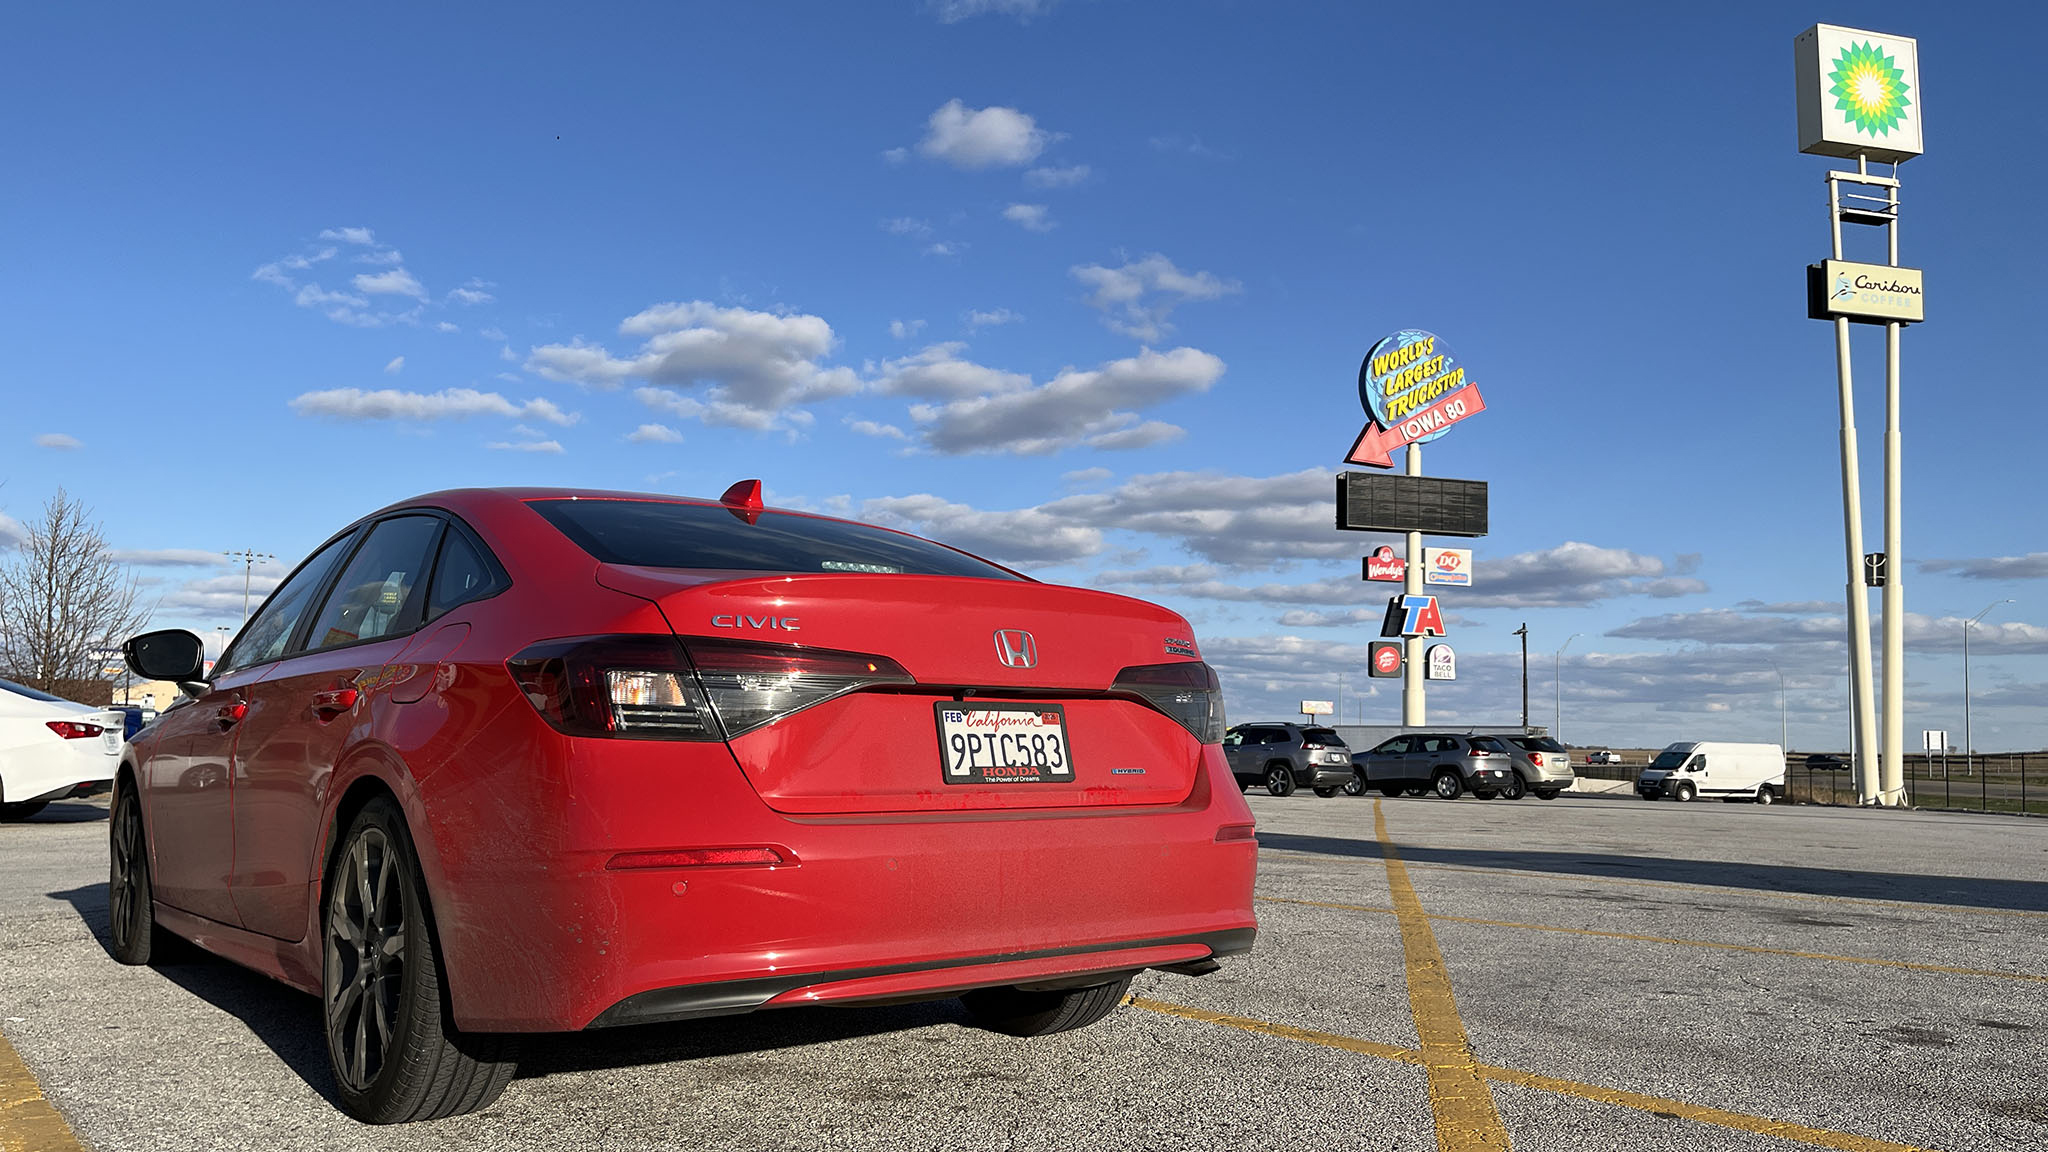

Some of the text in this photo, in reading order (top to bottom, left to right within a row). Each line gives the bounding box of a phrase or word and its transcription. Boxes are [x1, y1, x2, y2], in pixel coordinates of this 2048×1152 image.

[1855, 275, 1921, 294] Caribou
[1861, 293, 1911, 307] COFFEE
[1373, 336, 1434, 378] WORLD'S
[1385, 355, 1444, 397] LARGEST
[1386, 368, 1464, 421] TRUCKSTOP
[1400, 399, 1466, 441] IOWA 80
[1369, 562, 1404, 579] Wendy's
[1440, 555, 1458, 568] DQ
[711, 614, 800, 631] CIVIC
[1402, 595, 1446, 635] TA
[1433, 664, 1452, 672] TACO
[944, 712, 963, 723] FEB
[966, 710, 1043, 732] California
[951, 733, 1064, 770] 9PTC583
[982, 767, 1040, 777] HONDA
